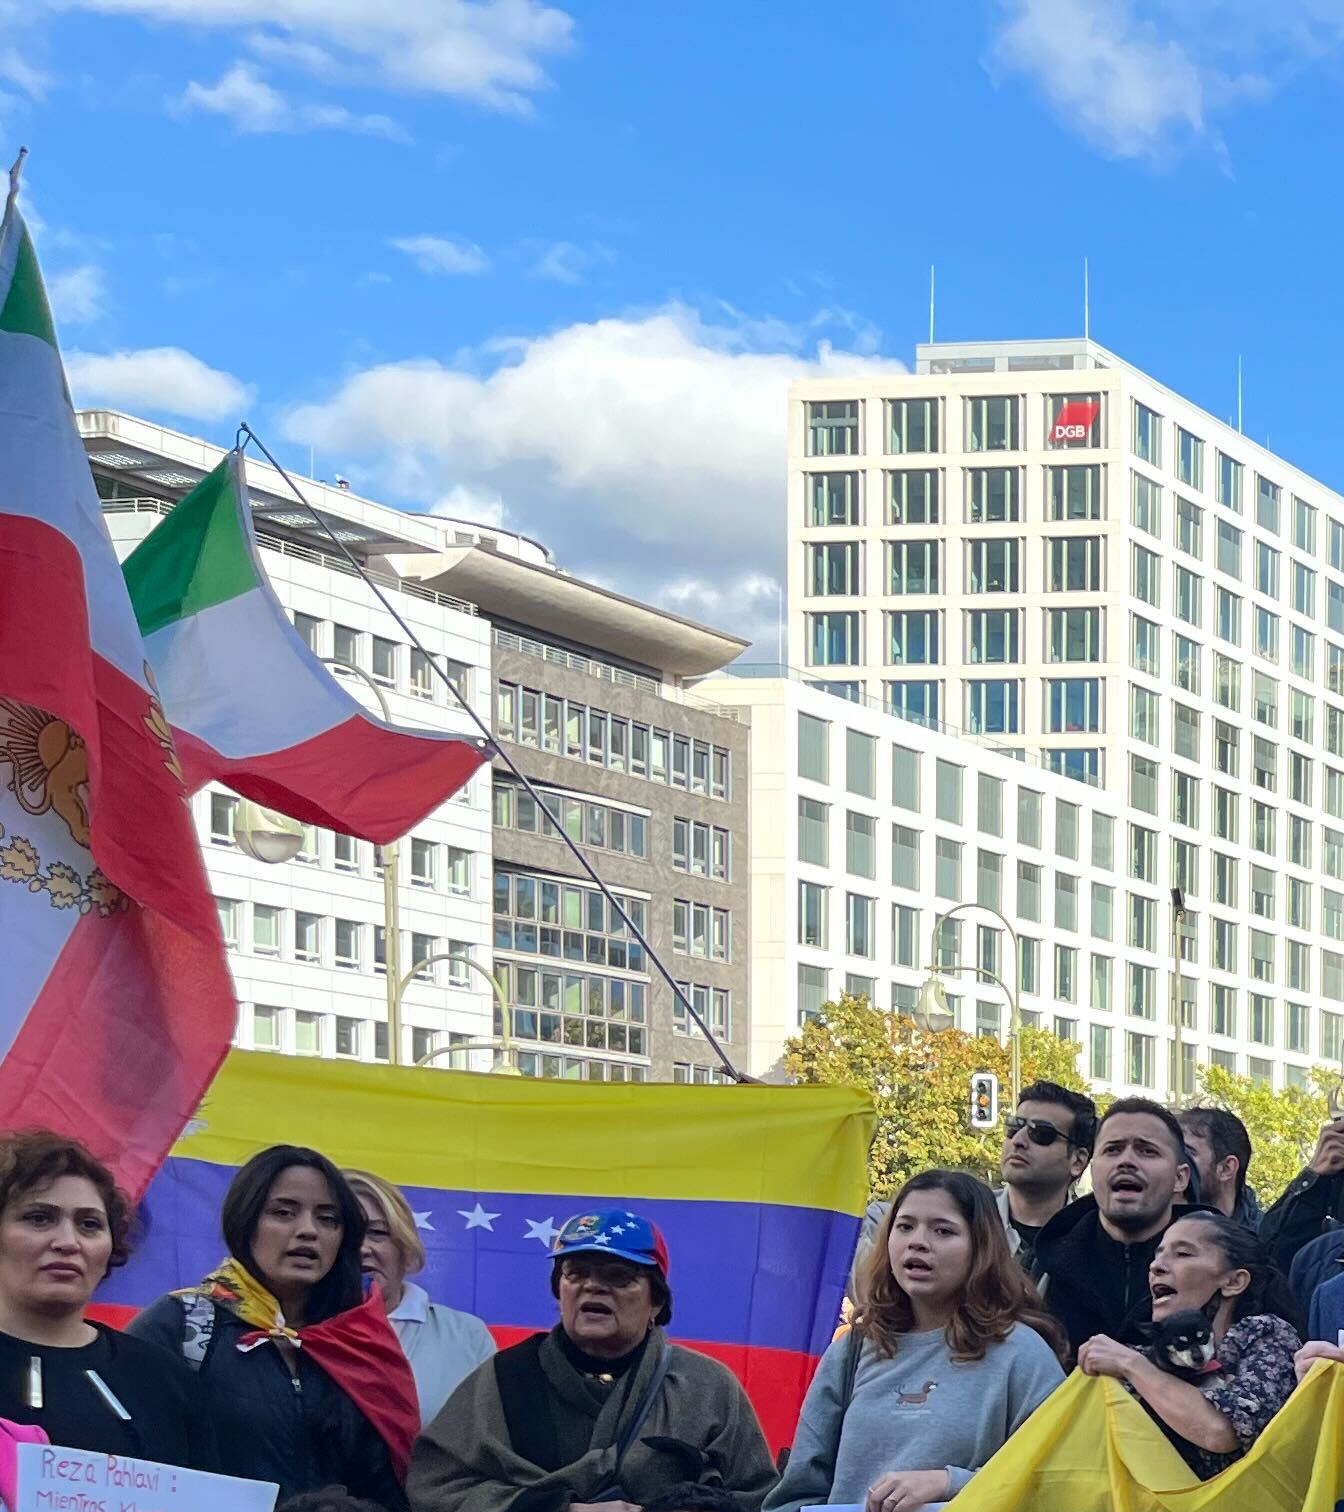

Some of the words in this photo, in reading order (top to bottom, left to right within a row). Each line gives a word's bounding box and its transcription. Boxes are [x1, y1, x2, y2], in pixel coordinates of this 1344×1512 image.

[1055, 424, 1086, 439] DGB
[41, 1449, 97, 1485] Reza
[106, 1454, 161, 1492] Pahlavi
